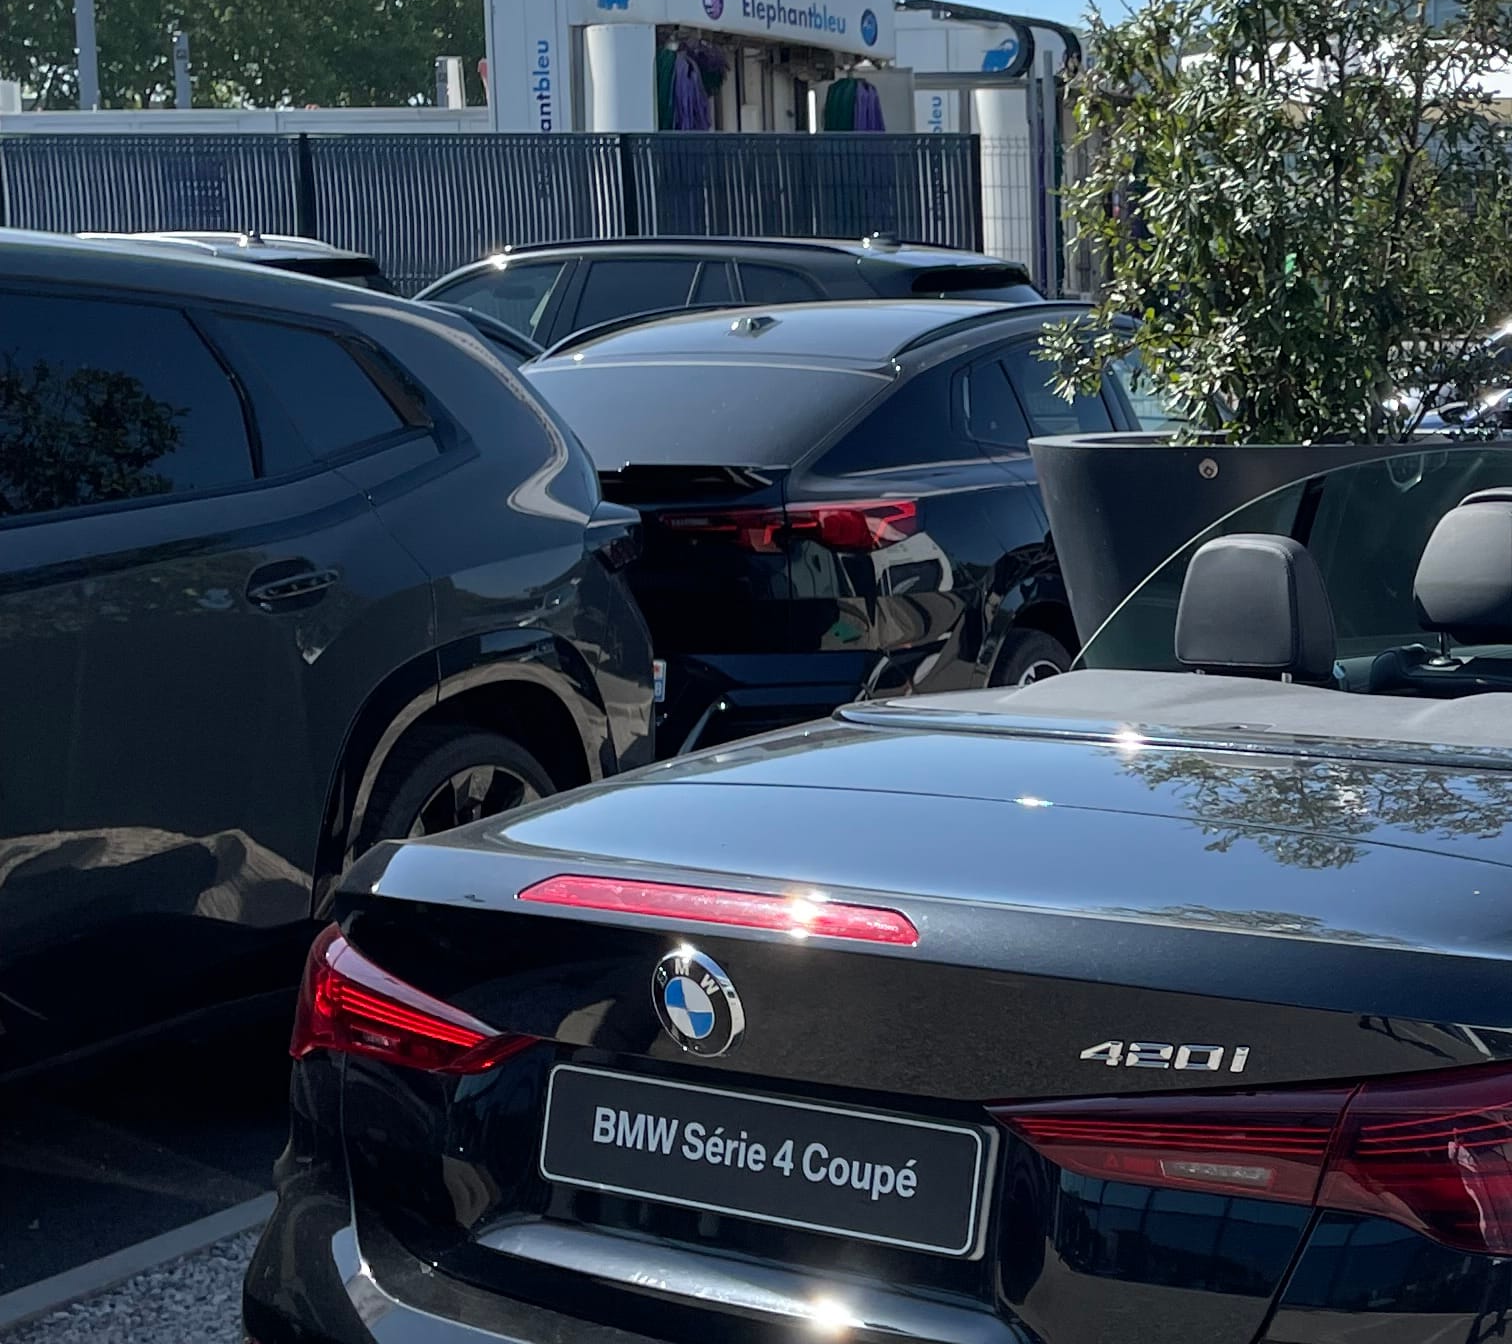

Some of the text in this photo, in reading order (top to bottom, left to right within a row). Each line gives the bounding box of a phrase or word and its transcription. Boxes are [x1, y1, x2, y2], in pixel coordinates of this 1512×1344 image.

[592, 1106, 918, 1201] BMW Série 4 Coupé
